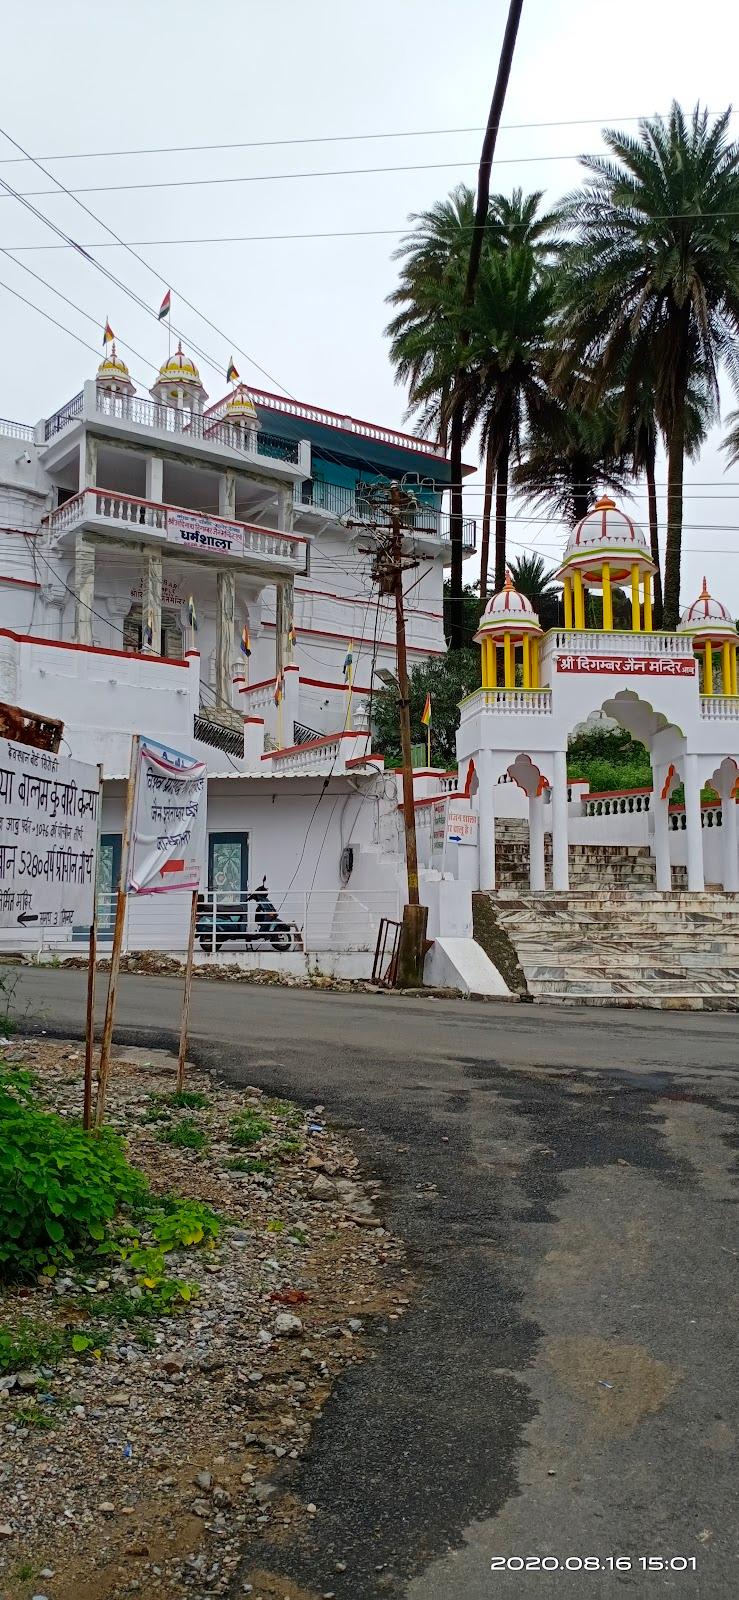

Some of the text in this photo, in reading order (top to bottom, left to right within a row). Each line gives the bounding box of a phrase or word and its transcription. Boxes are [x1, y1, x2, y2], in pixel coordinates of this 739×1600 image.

[180, 530, 232, 550] धर्मशाला
[560, 656, 575, 670] श्री
[576, 657, 622, 671] दिगम्बर
[623, 658, 648, 672] जैन
[648, 659, 682, 674] मन्दिर
[18, 774, 52, 812] बालम
[78, 789, 99, 821] कन्या
